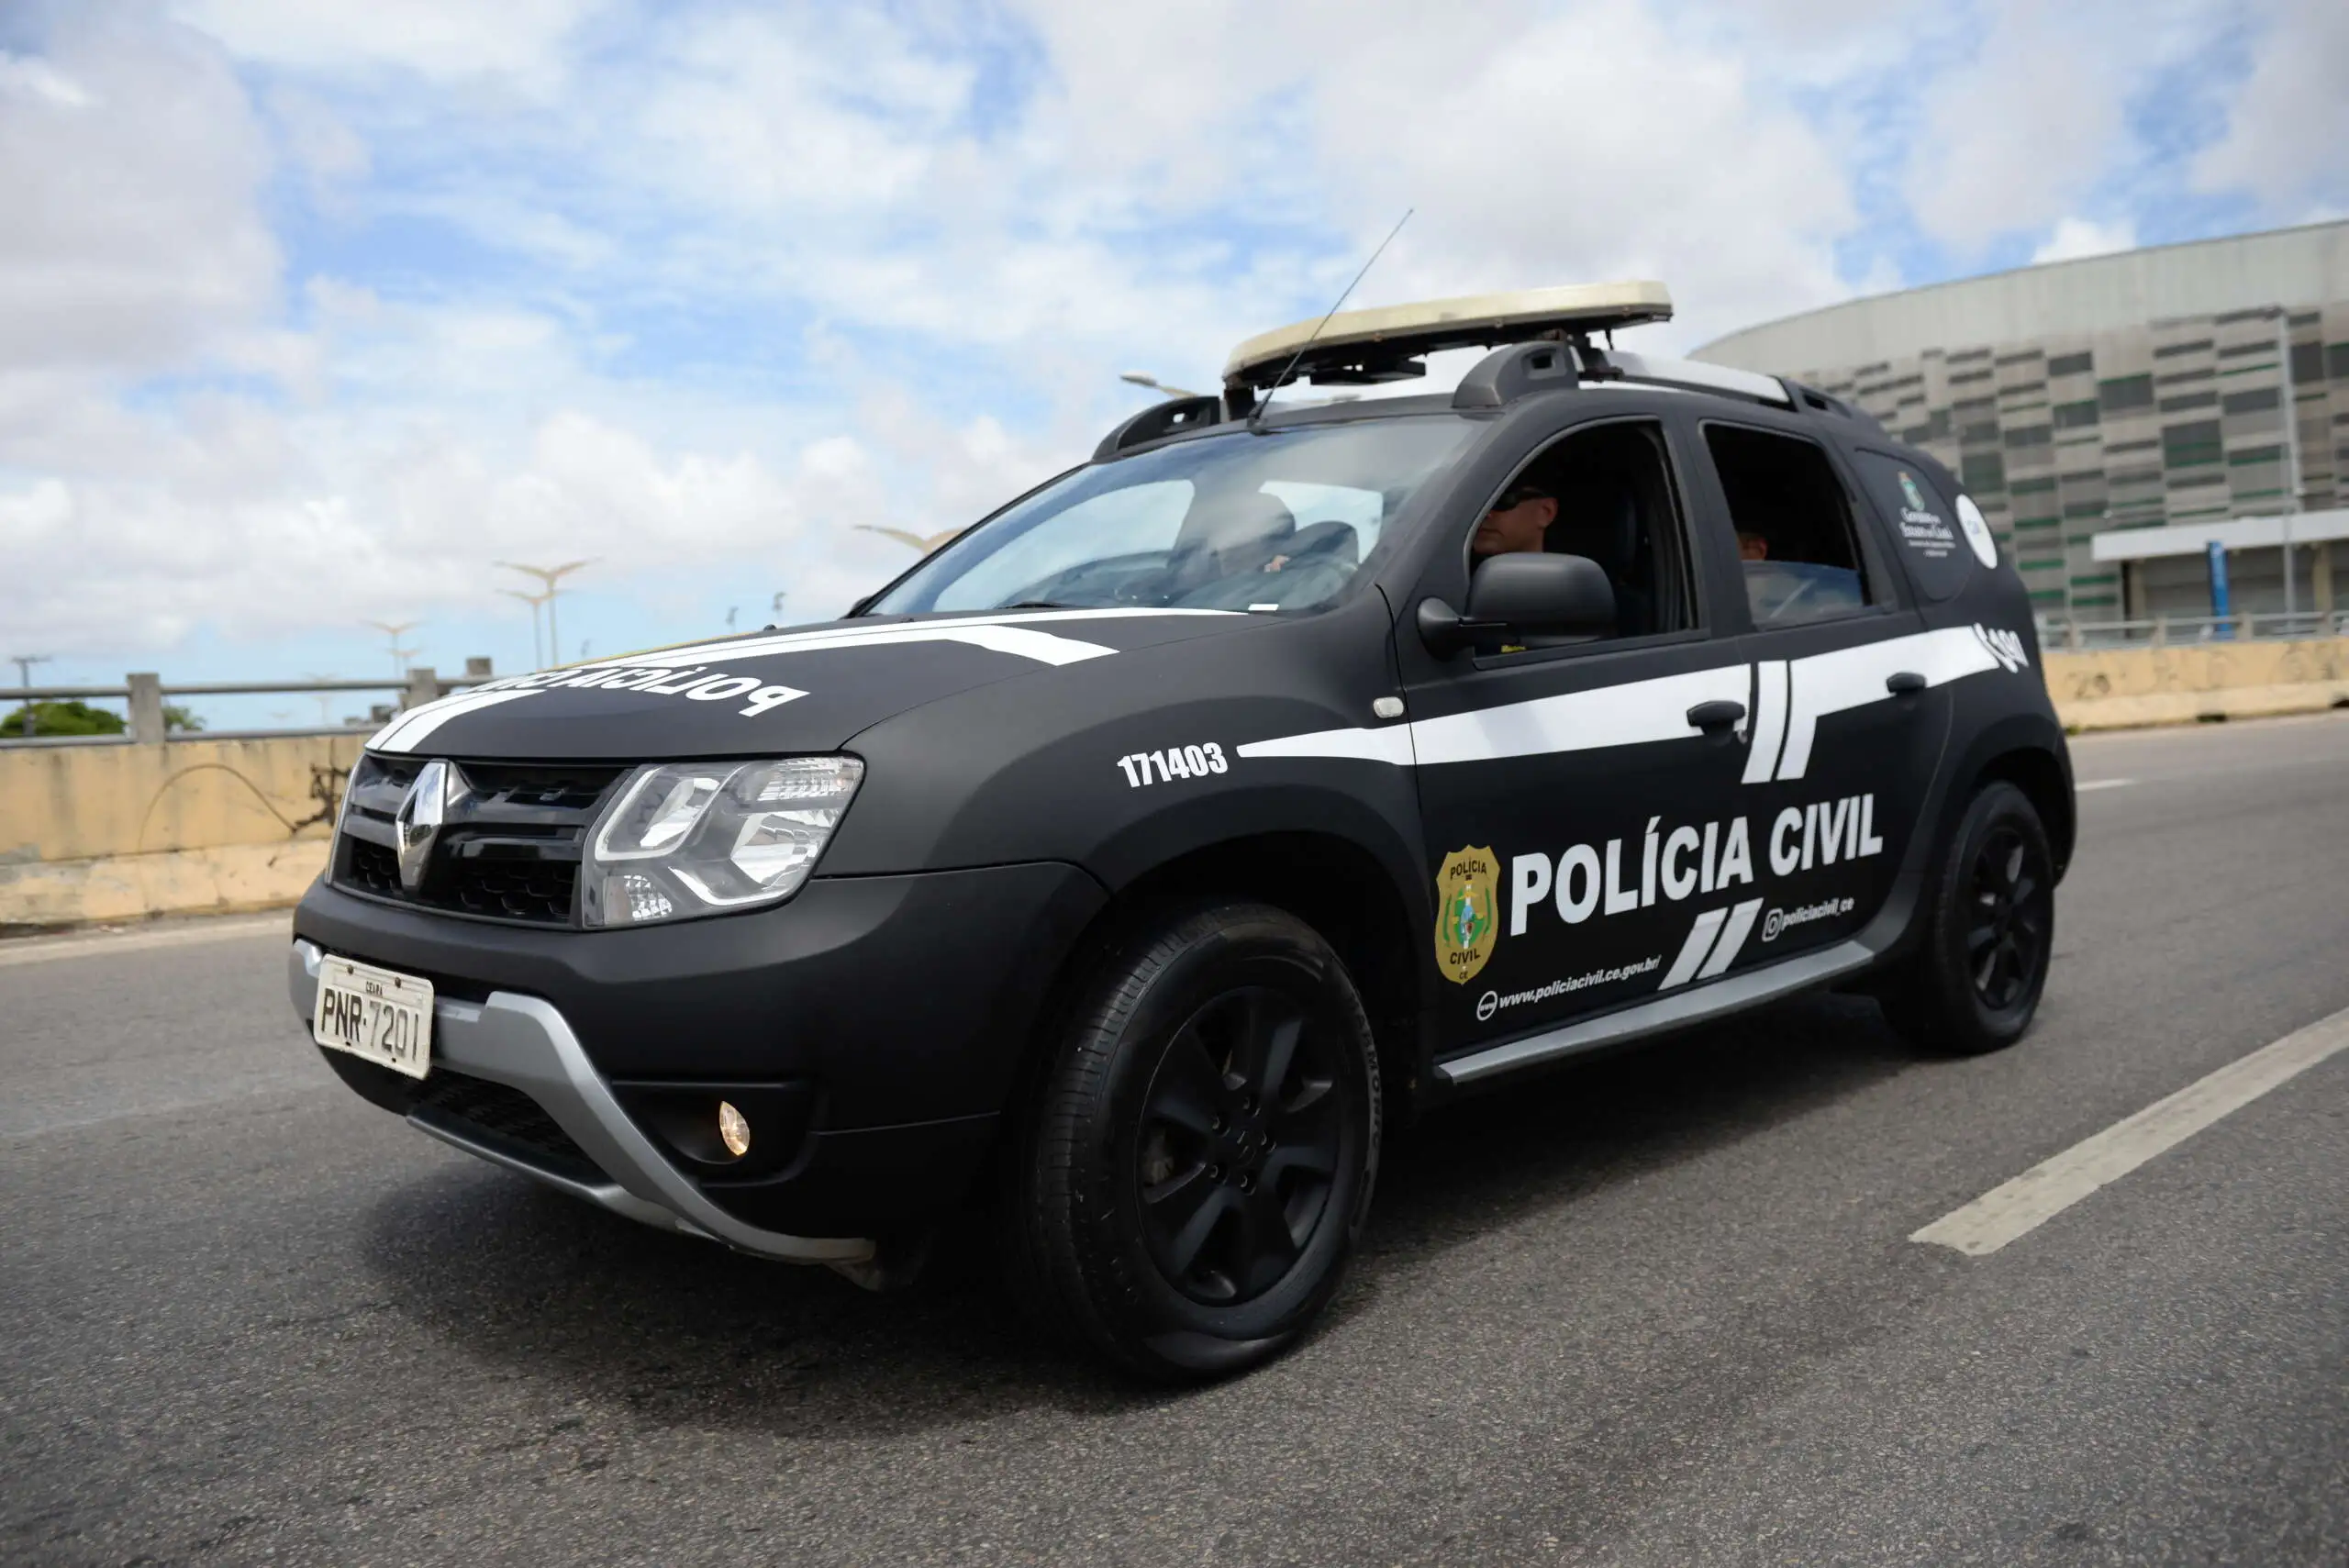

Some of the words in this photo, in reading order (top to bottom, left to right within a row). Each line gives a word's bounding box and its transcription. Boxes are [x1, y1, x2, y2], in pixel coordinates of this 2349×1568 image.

[1117, 742, 1229, 787] 171403
[1510, 816, 1753, 936] POLÍCIA
[1769, 794, 1883, 876] CIVIL
[1450, 948, 1481, 964] CIVIL
